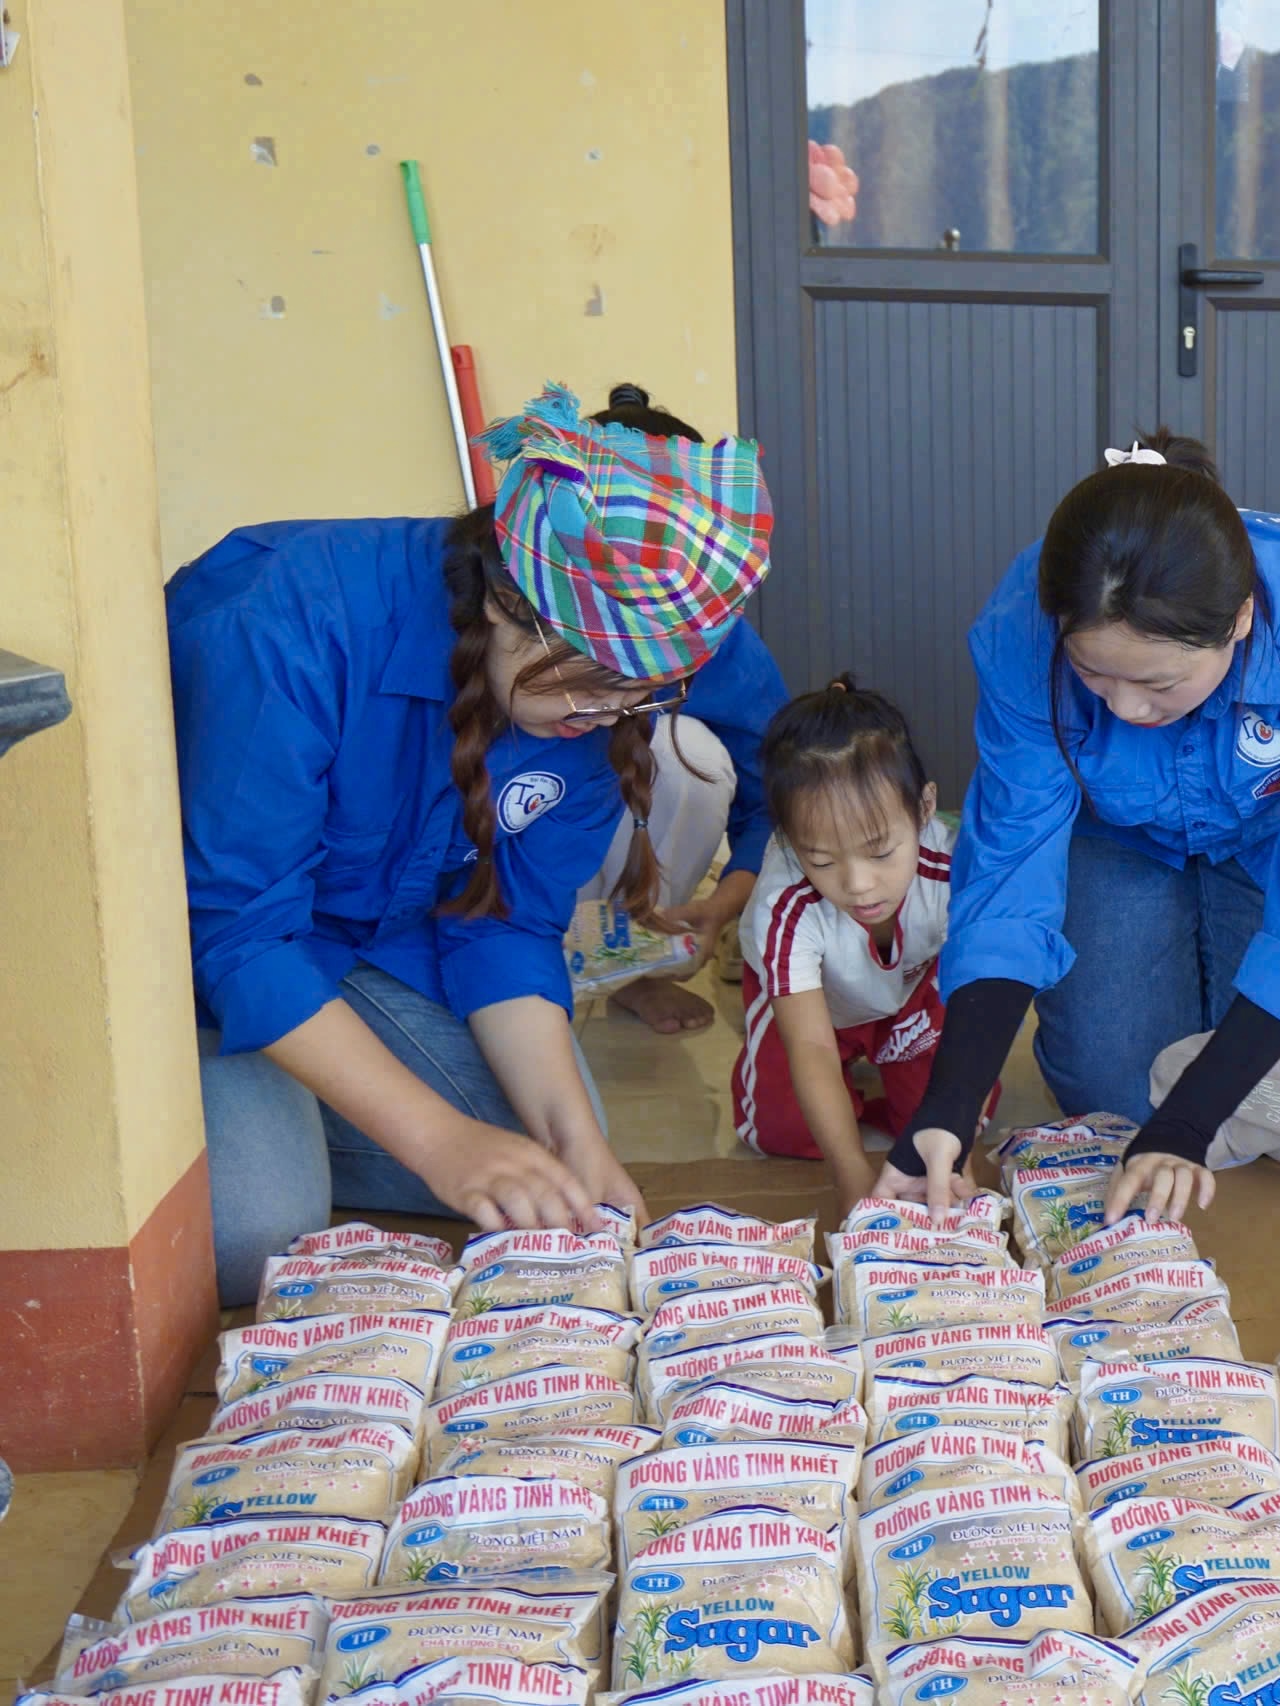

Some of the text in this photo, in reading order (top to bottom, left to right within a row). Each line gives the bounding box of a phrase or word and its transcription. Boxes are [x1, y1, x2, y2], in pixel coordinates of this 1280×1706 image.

[1040, 1188, 1056, 1197] TH
[876, 1218, 892, 1228] TH
[737, 1226, 767, 1242] TINH
[744, 1256, 774, 1274] TINH
[1078, 1258, 1093, 1271] TH
[1133, 1269, 1164, 1285] TINH
[1168, 1266, 1204, 1289] KHIẾT
[733, 1294, 767, 1312] TINH
[1002, 1294, 1026, 1303] NAM
[350, 1314, 383, 1335] TINH
[773, 1318, 800, 1327] NAM
[931, 1328, 972, 1346] VÀNG
[976, 1326, 1011, 1339] TINH
[1080, 1333, 1099, 1343] TH
[463, 1345, 483, 1358] TH
[1016, 1357, 1041, 1366] NAM
[543, 1373, 579, 1393] TINH
[1186, 1370, 1222, 1388] TINH
[324, 1383, 362, 1403] TINH
[1111, 1391, 1130, 1400] TH
[585, 1401, 613, 1413] NAM
[455, 1422, 476, 1431] TH
[779, 1414, 814, 1433] TINH
[908, 1417, 928, 1425] TH
[1160, 1417, 1222, 1426] YELLOW
[931, 1432, 976, 1455] VÀNG
[982, 1438, 1017, 1460] TINH
[585, 1452, 616, 1465] NAM
[693, 1452, 739, 1482] VÀNG
[745, 1453, 785, 1476] TINH
[791, 1454, 839, 1475] KHIẾT
[246, 1493, 318, 1508] YELLOW
[458, 1482, 553, 1512] VÀNG TINH
[875, 1485, 1031, 1540] ĐƯỜNG VÀNG TINH
[415, 1527, 437, 1542] TH
[551, 1527, 584, 1540] NAM
[1041, 1523, 1071, 1531] NAM
[268, 1526, 371, 1548] TINH KHIẾT
[693, 1522, 791, 1551] VÀNG TINH
[903, 1538, 924, 1557] TH
[1204, 1558, 1271, 1571] YELLOW
[960, 1565, 1031, 1582] YELLOW
[645, 1578, 669, 1588] TH
[466, 1596, 512, 1614] TINH
[702, 1598, 775, 1616] YELLOW
[1186, 1582, 1278, 1627] VÀNG TINH
[197, 1610, 244, 1633] TINH
[251, 1604, 310, 1631] KHIẾT
[351, 1630, 376, 1647] TH
[507, 1629, 544, 1642] NAM
[466, 1662, 512, 1691] TINH
[929, 1677, 953, 1691] TH
